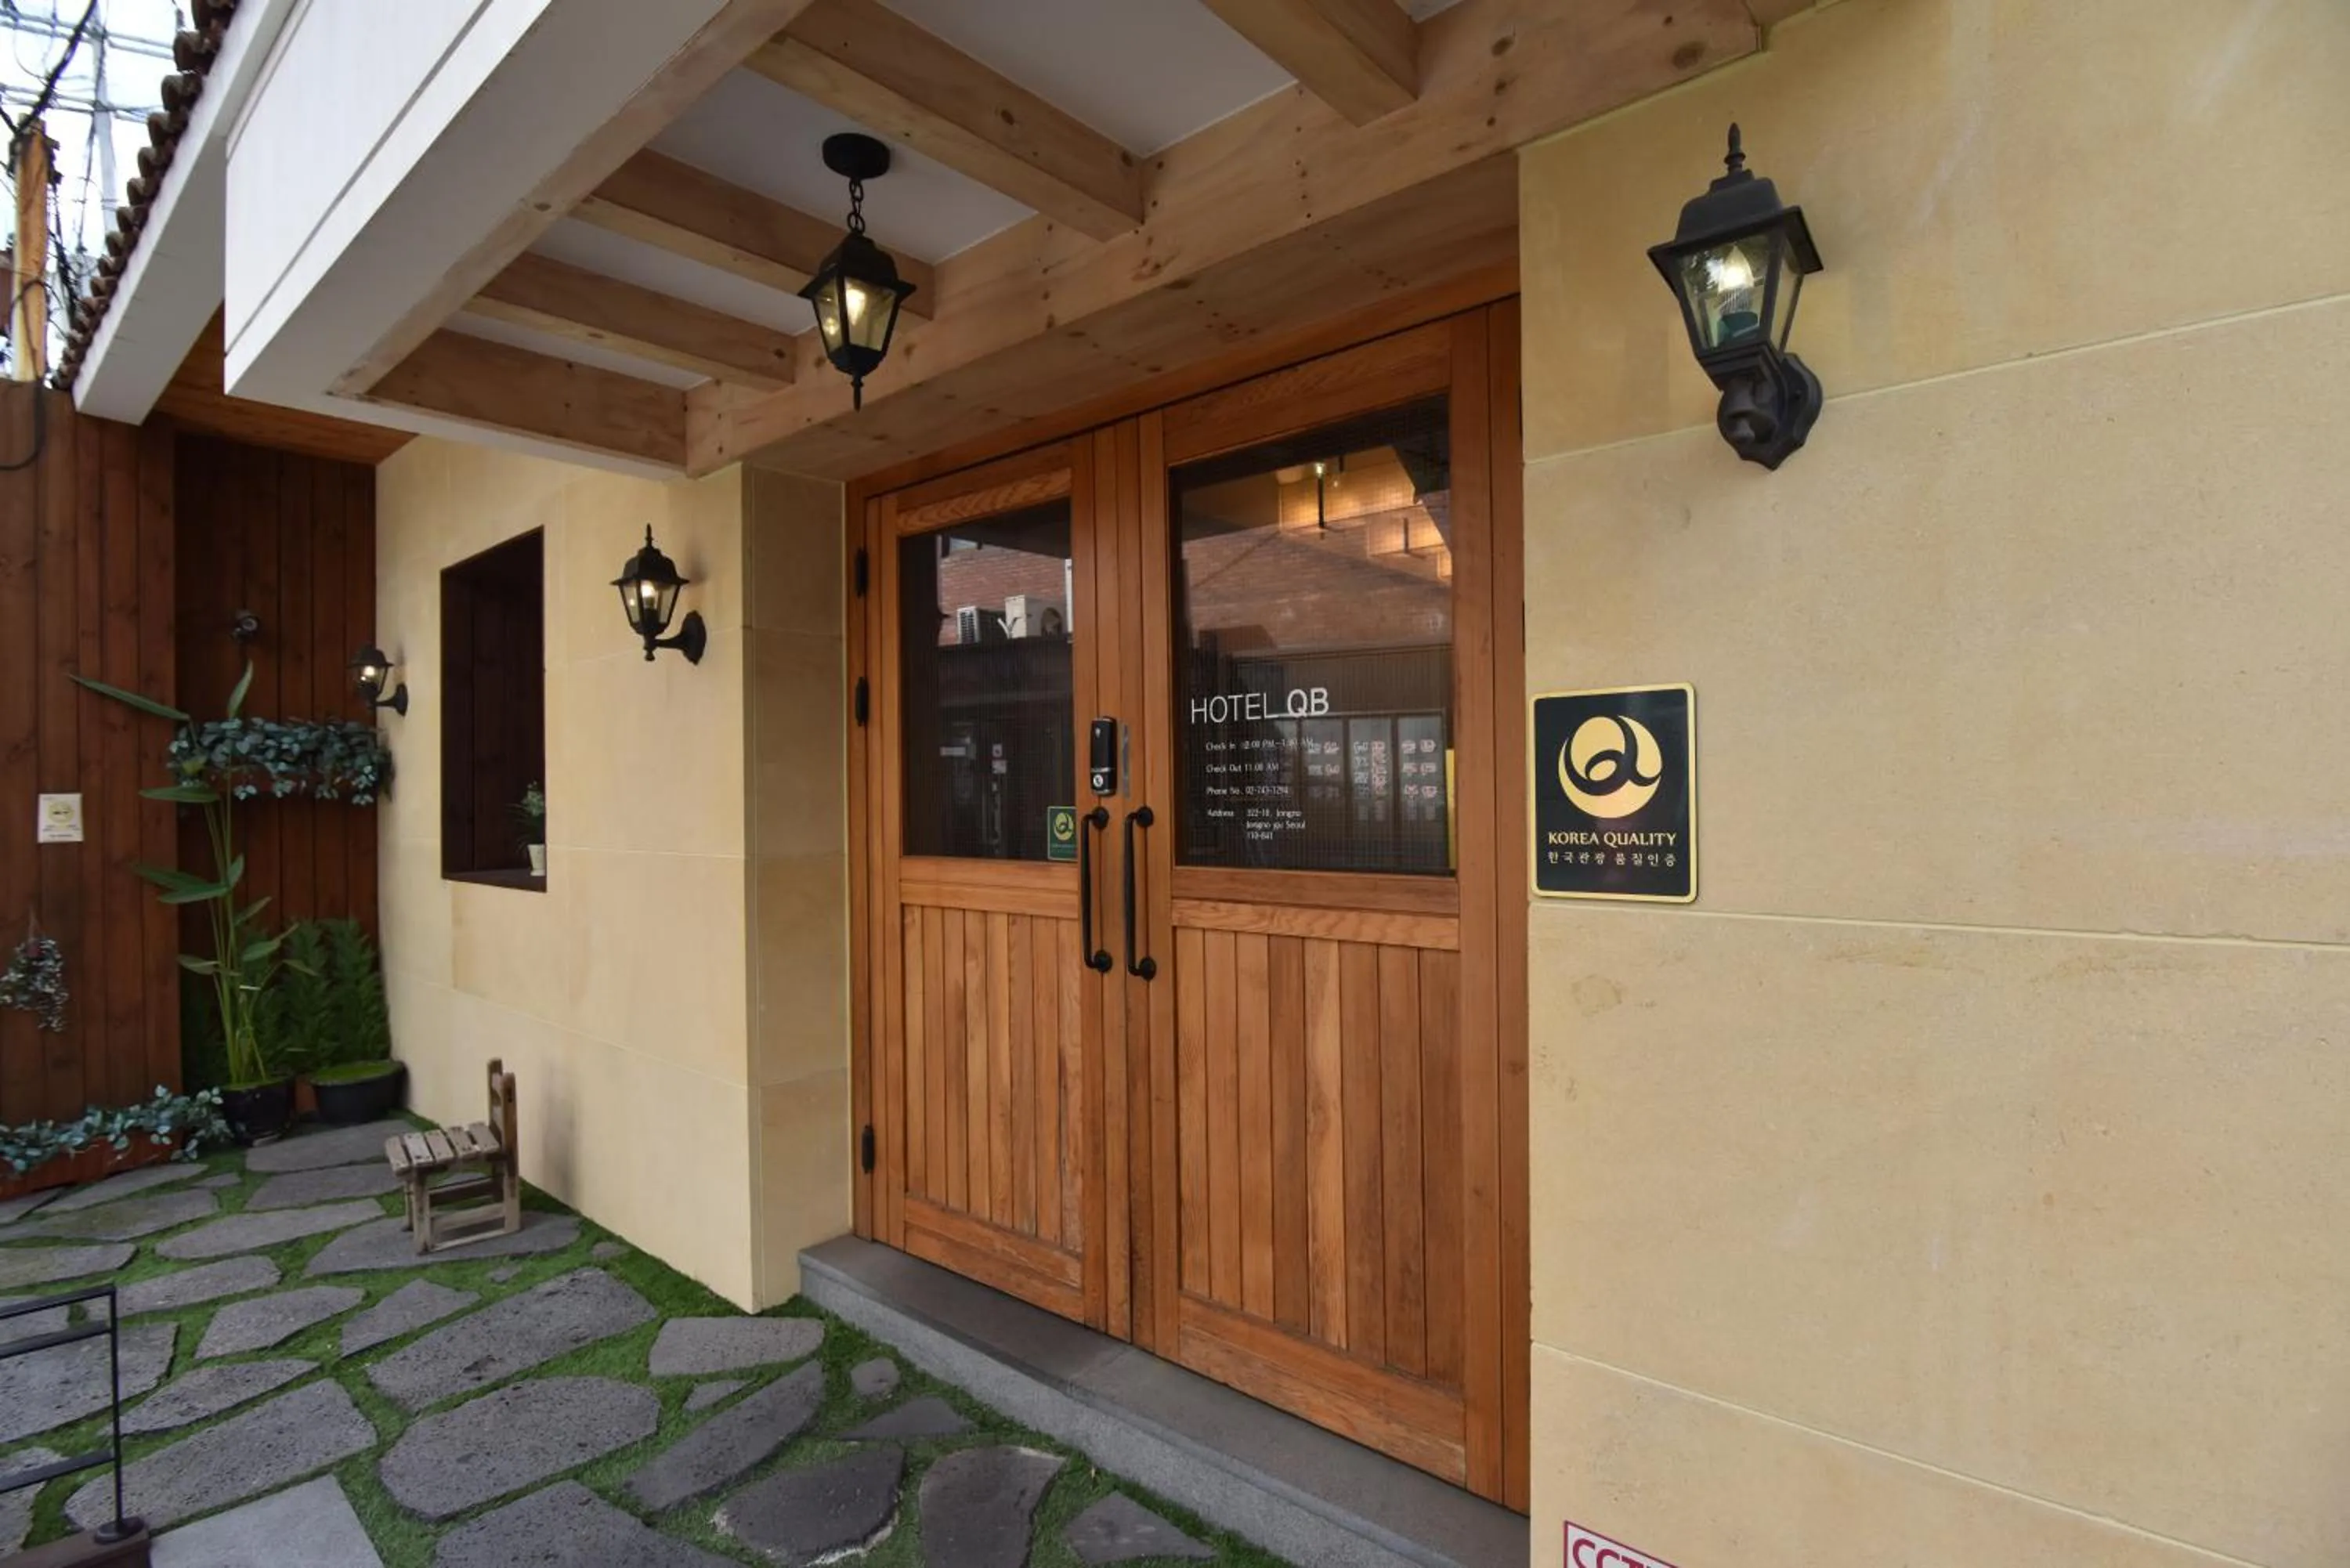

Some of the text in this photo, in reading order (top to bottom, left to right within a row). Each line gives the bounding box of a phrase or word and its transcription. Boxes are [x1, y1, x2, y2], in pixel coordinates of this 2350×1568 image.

[1191, 687, 1329, 724] HOTEL QB
[1206, 739, 1226, 750] Check
[1206, 764, 1226, 772] Check
[1266, 762, 1279, 771] AM
[1206, 786, 1227, 795] Phone
[1207, 808, 1235, 817] Address
[1285, 820, 1306, 829] Seoul
[1548, 831, 1676, 848] KOREA QUALITY
[1614, 852, 1676, 868] 품질인증
